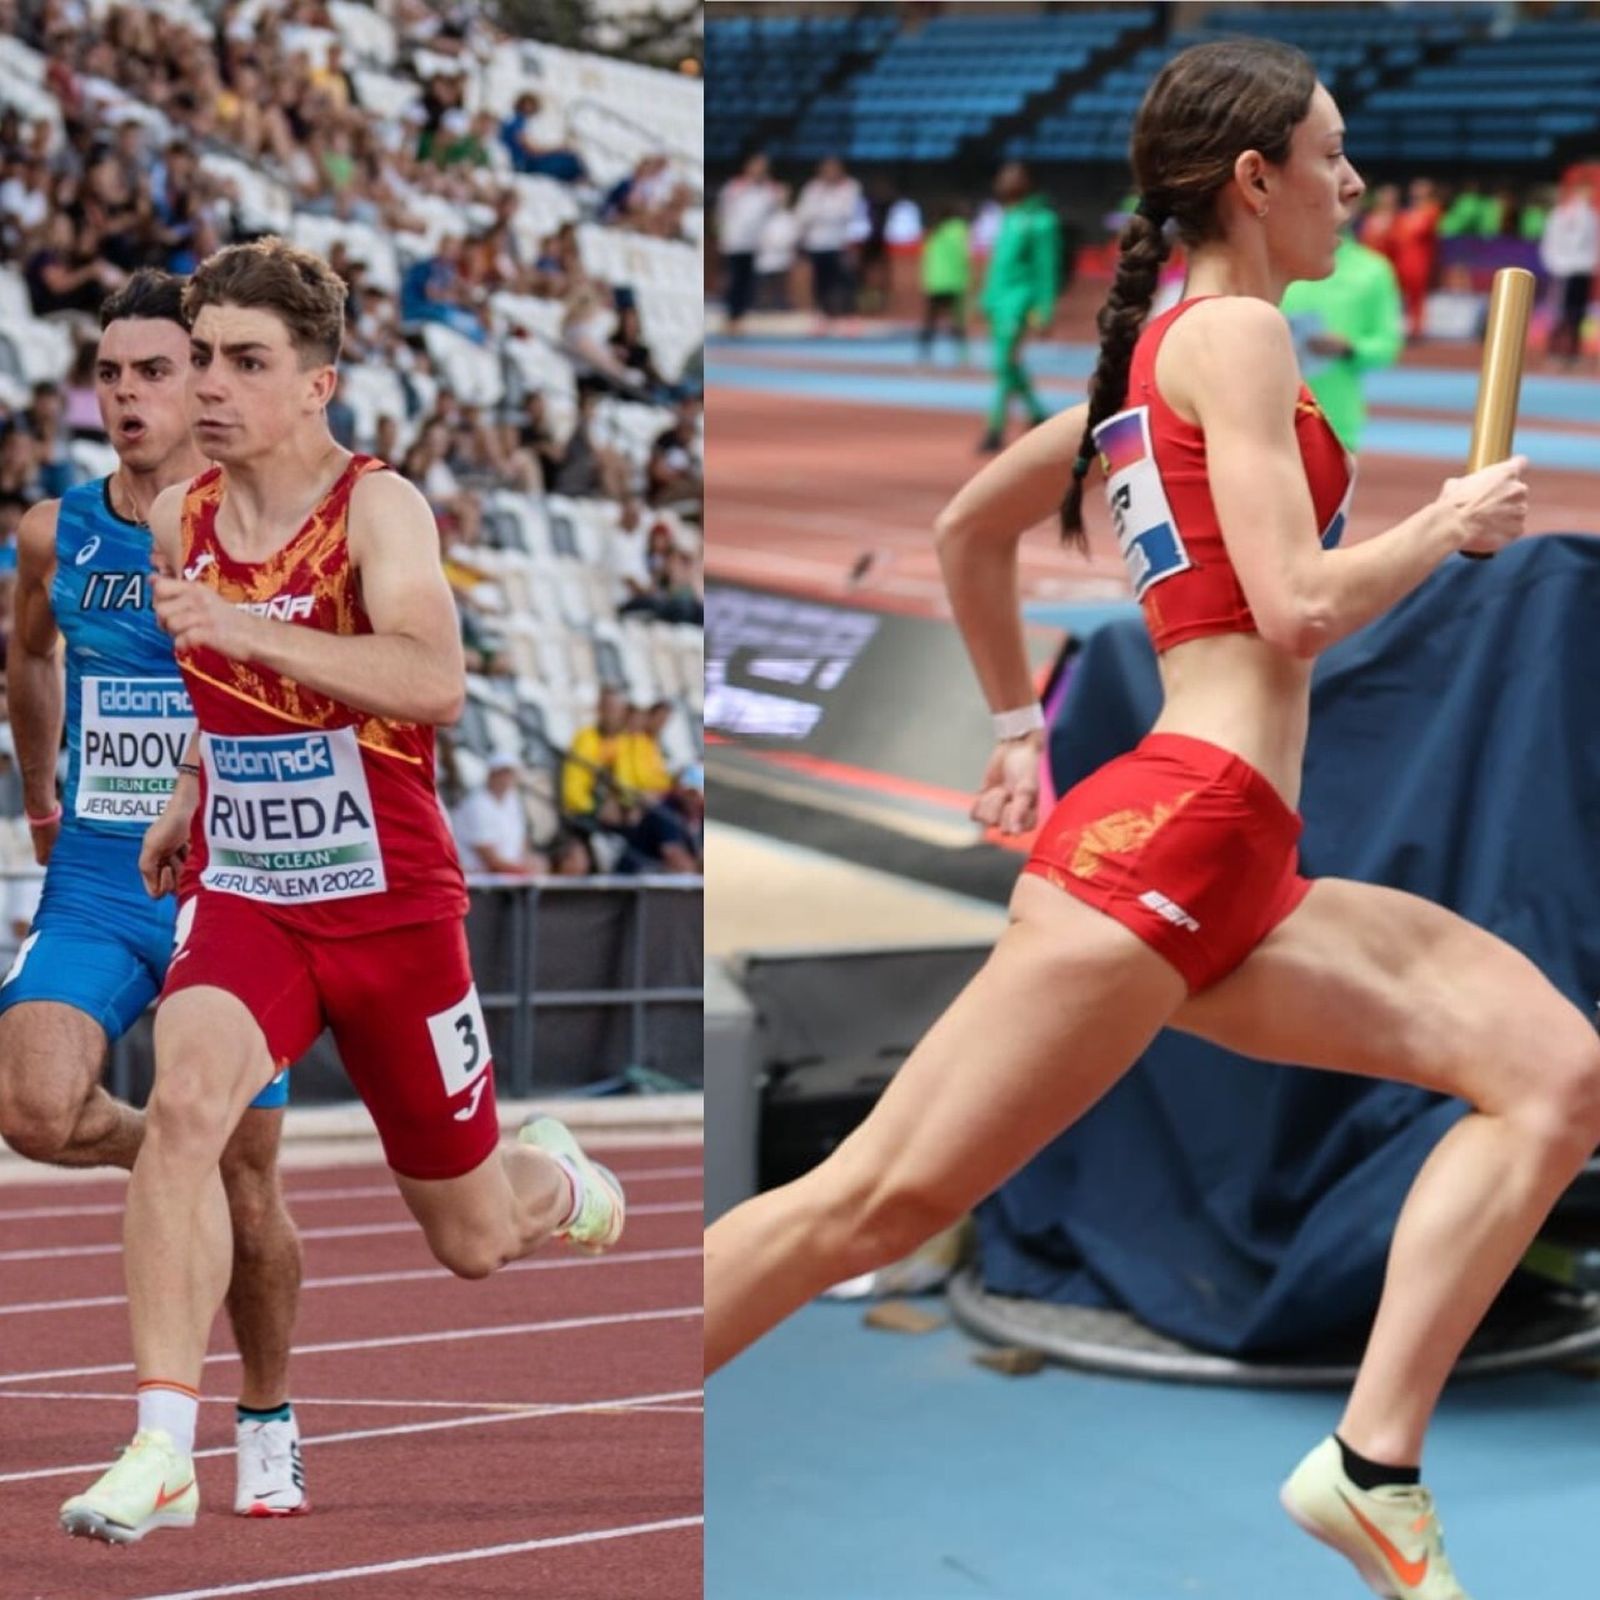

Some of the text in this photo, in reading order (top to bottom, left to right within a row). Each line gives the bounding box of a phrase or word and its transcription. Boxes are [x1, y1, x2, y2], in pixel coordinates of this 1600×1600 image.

[81, 572, 156, 612] ITA
[85, 731, 187, 768] PADOV
[116, 779, 145, 792] RUN
[210, 790, 371, 841] RUEDA
[206, 867, 377, 897] JERUSALEM 2022
[454, 1012, 480, 1074] 3
